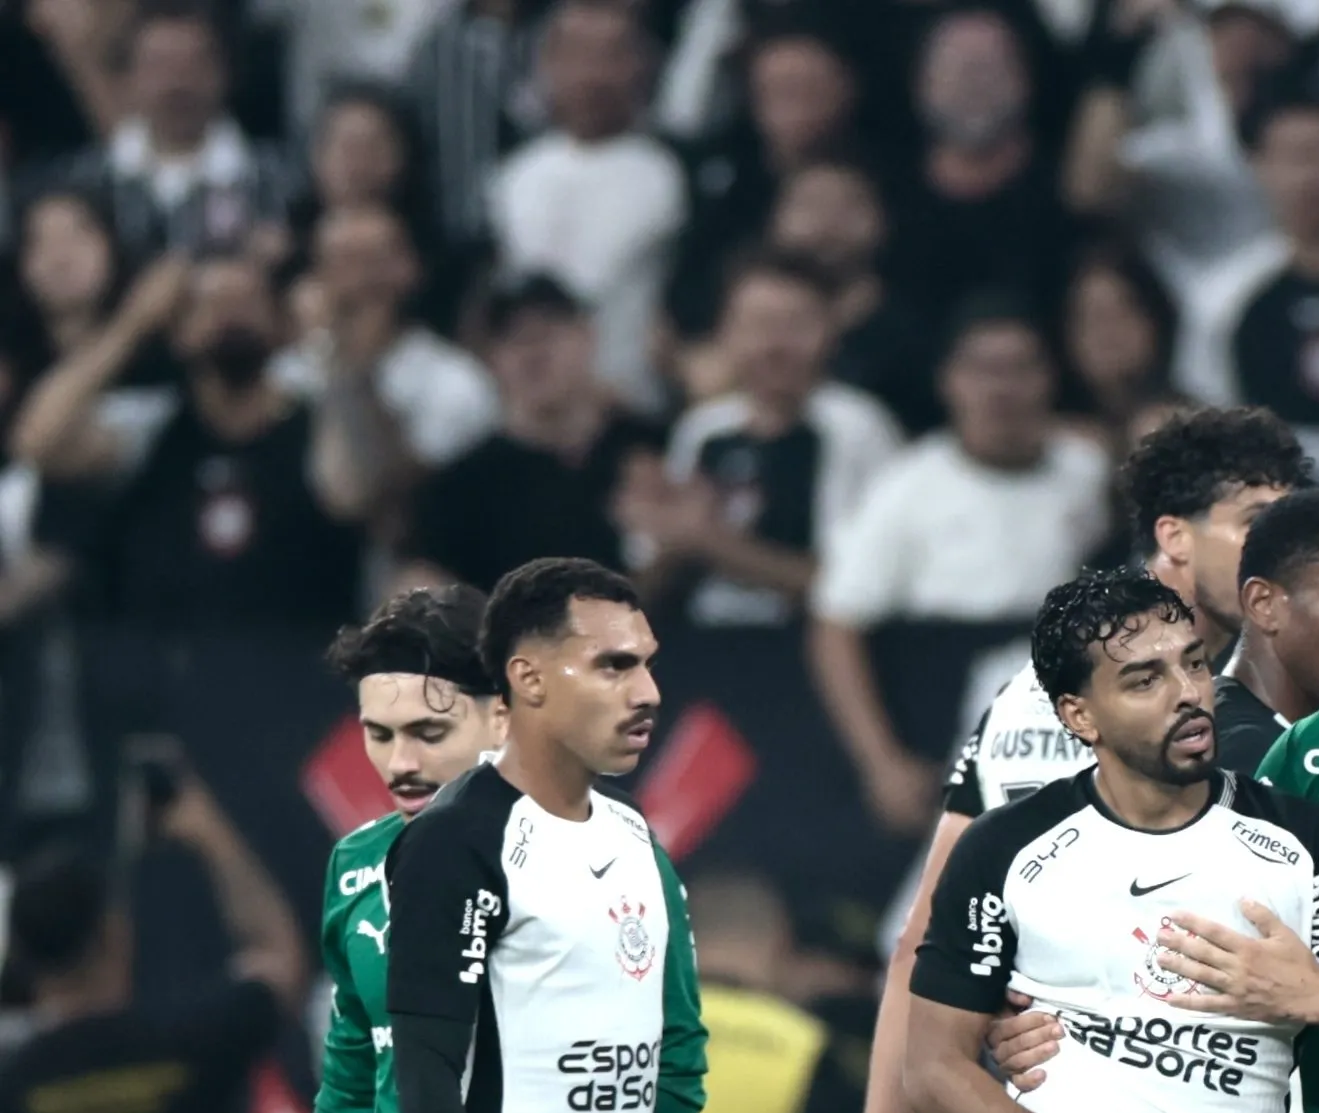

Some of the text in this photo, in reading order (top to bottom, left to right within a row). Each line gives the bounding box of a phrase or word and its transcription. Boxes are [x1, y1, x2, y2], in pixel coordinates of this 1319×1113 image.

[1019, 826, 1081, 884] BYD
[1231, 819, 1301, 867] Frimesa
[460, 898, 473, 936] banco
[461, 889, 501, 960] bmg
